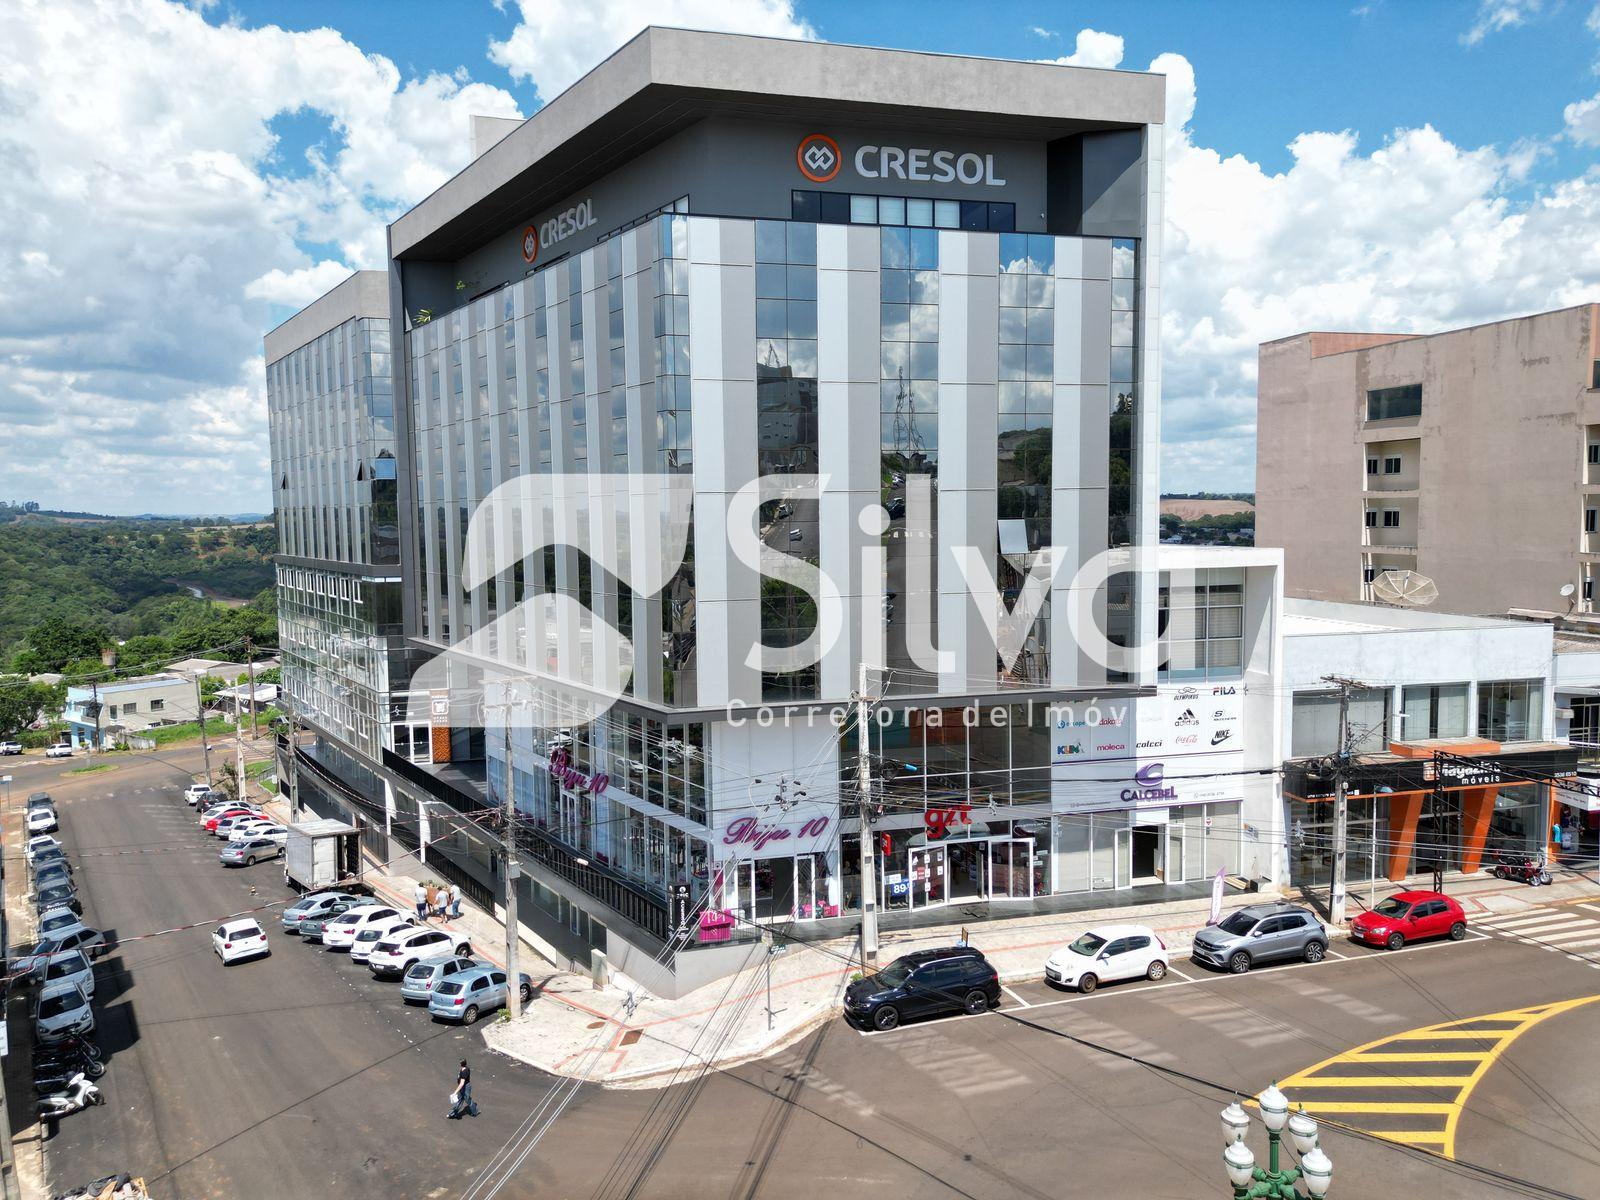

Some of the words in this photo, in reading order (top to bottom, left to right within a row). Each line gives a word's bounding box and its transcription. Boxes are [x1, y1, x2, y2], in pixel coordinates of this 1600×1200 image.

[854, 145, 1007, 186] CRESOL
[540, 198, 598, 249] CRESOL
[1213, 686, 1236, 696] FILA
[1174, 719, 1200, 727] adidas
[1214, 729, 1231, 739] NIKE
[1096, 743, 1125, 751] moleca
[1136, 740, 1163, 749] colcci
[588, 772, 609, 793] 10
[1461, 775, 1501, 785] móveis
[1120, 786, 1178, 802] CALCEBEL
[797, 816, 830, 839] 10
